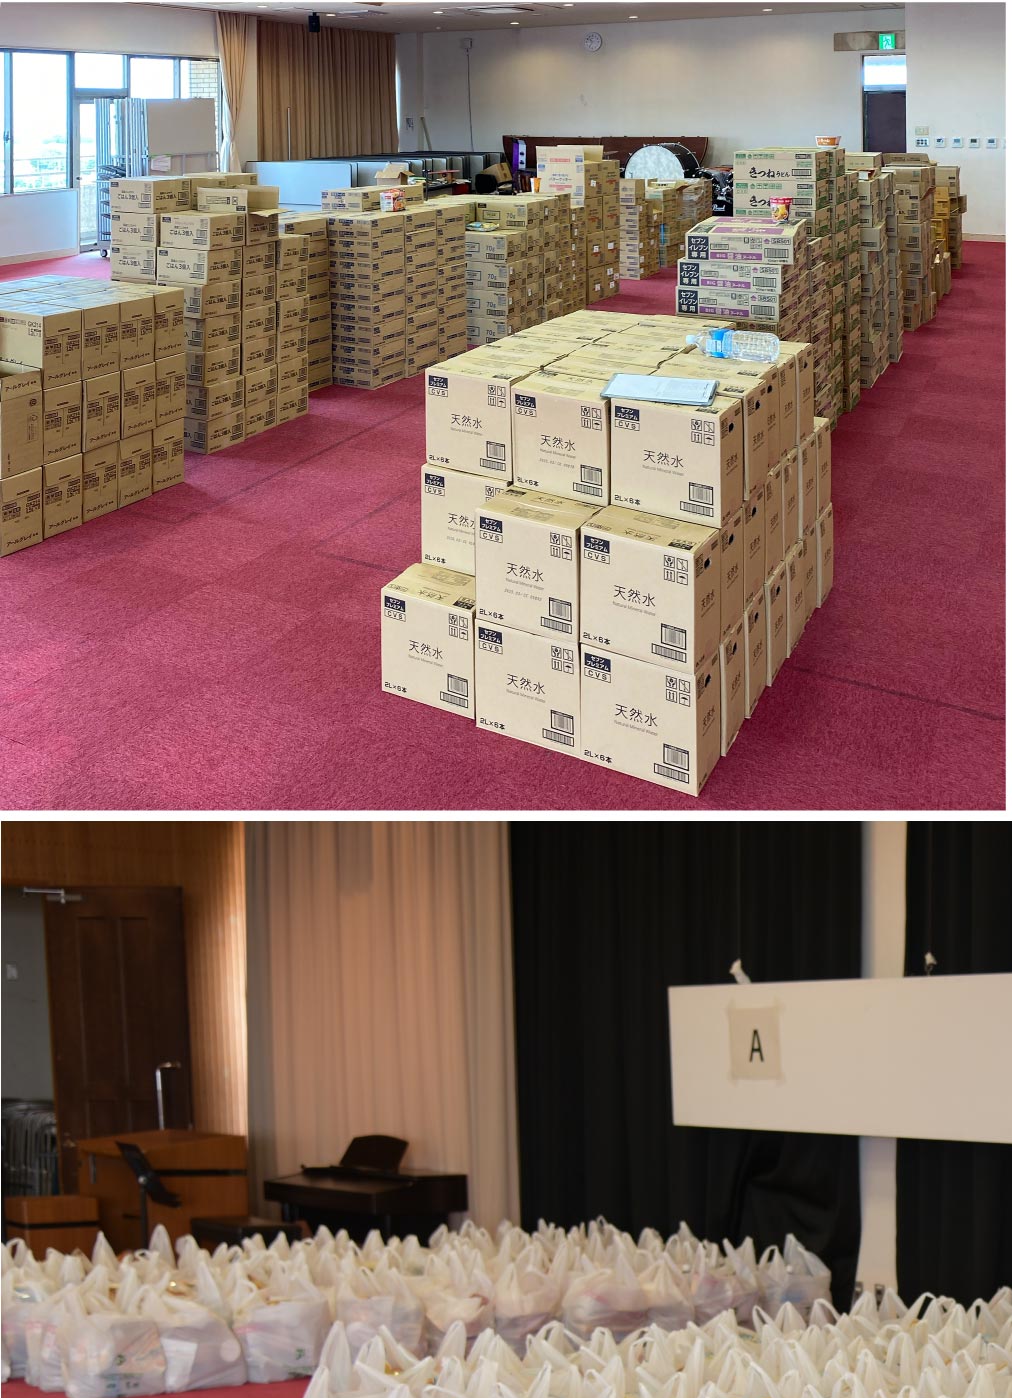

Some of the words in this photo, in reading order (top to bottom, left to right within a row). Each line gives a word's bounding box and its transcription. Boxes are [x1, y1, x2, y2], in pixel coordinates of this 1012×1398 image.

[750, 196, 770, 207] きつ
[451, 414, 483, 429] 天然水
[618, 421, 638, 430] CVS
[540, 435, 576, 451] 天然水
[643, 449, 684, 468] 天然水
[482, 531, 500, 542] CVS
[587, 552, 607, 562] CVS
[506, 562, 544, 582] 天然水
[613, 585, 656, 607] 天然水
[409, 639, 443, 660] 天然水
[481, 642, 500, 653] CVS
[587, 669, 608, 681] CVS
[507, 673, 546, 695] 天然水
[615, 704, 658, 727] 天然水
[748, 1029, 764, 1063] A
